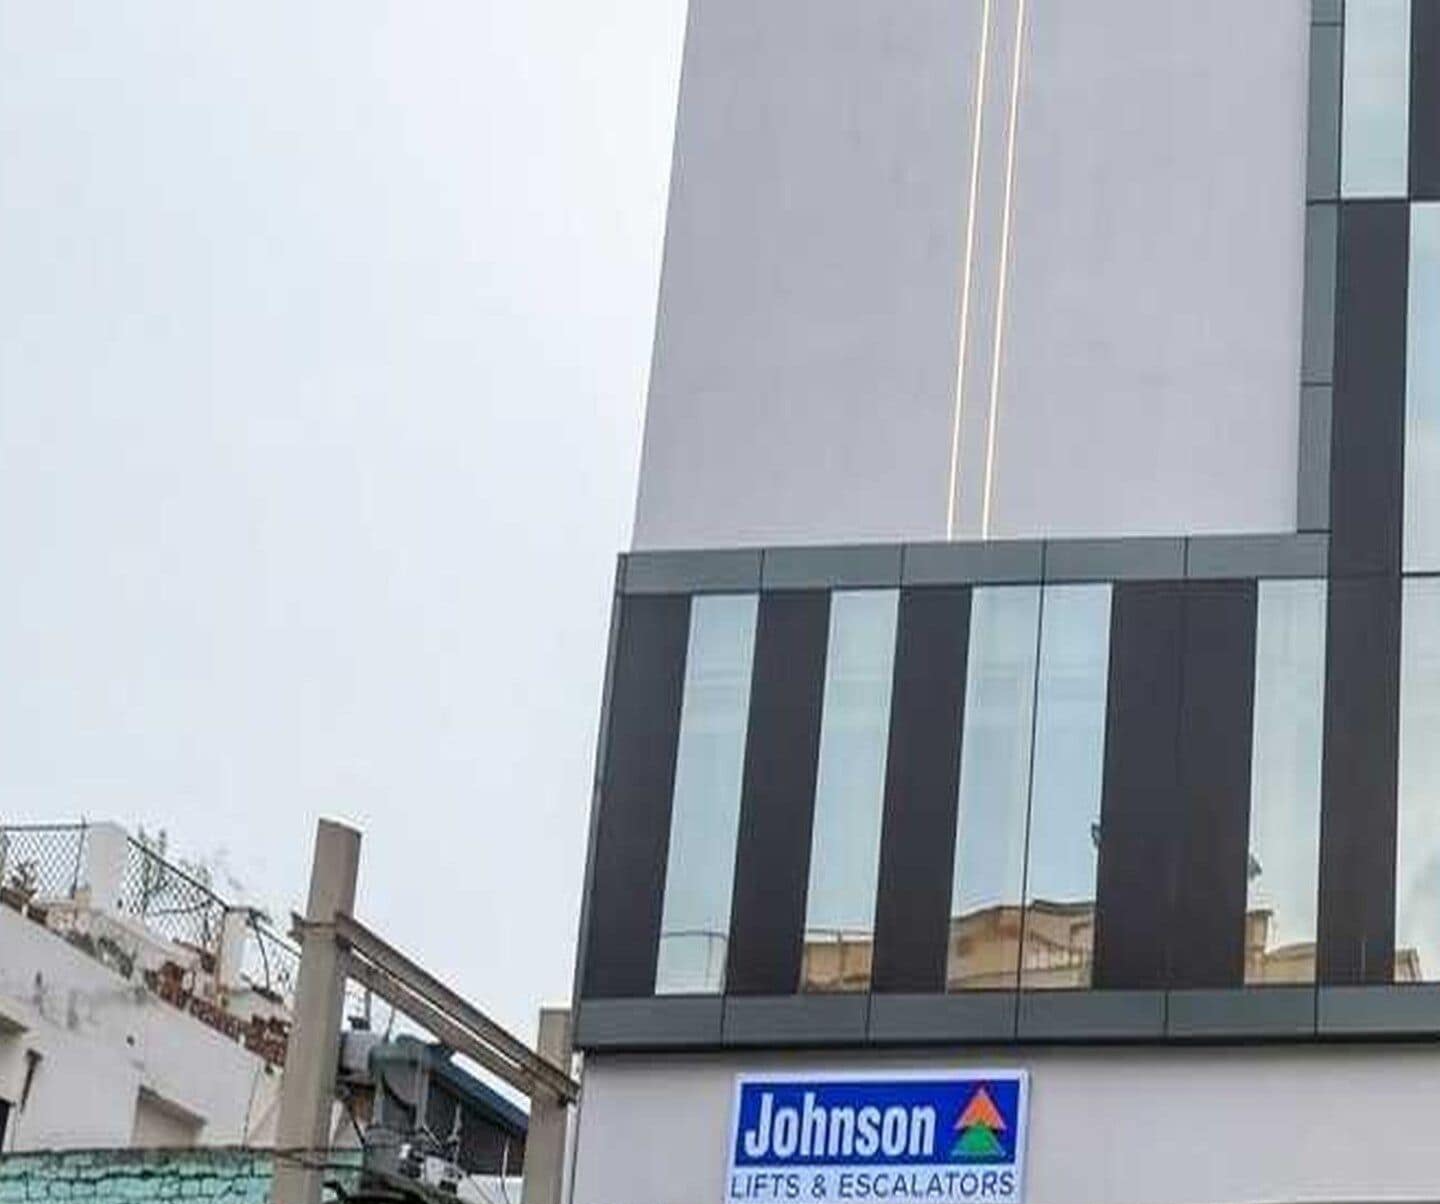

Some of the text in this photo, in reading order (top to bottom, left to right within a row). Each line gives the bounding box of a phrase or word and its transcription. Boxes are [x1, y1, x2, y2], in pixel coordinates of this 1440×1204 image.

[744, 1091, 937, 1158] Johnson
[730, 1169, 1016, 1200] LIFTS & ESCALATORS
